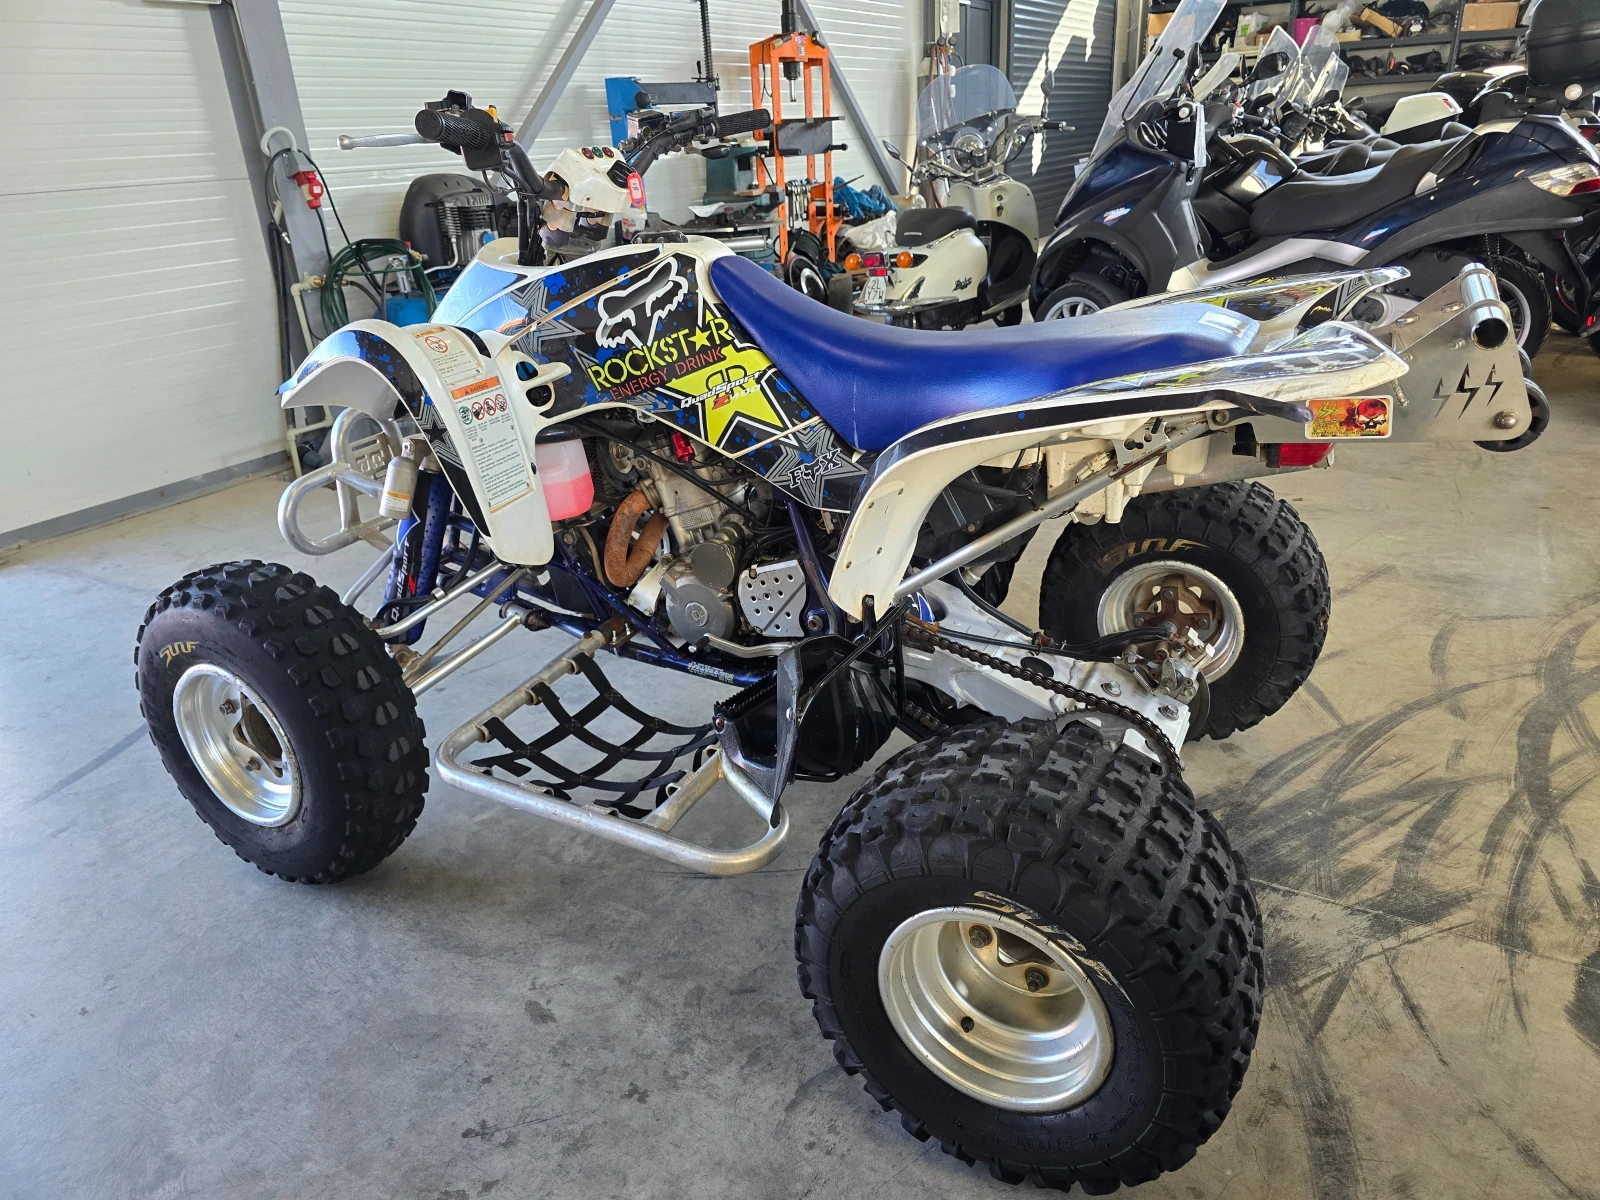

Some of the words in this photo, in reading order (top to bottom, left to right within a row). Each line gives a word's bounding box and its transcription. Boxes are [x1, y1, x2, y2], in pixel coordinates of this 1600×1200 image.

[609, 368, 668, 402] ENERGY
[674, 346, 725, 376] DRINK
[680, 370, 764, 409] QuadSport
